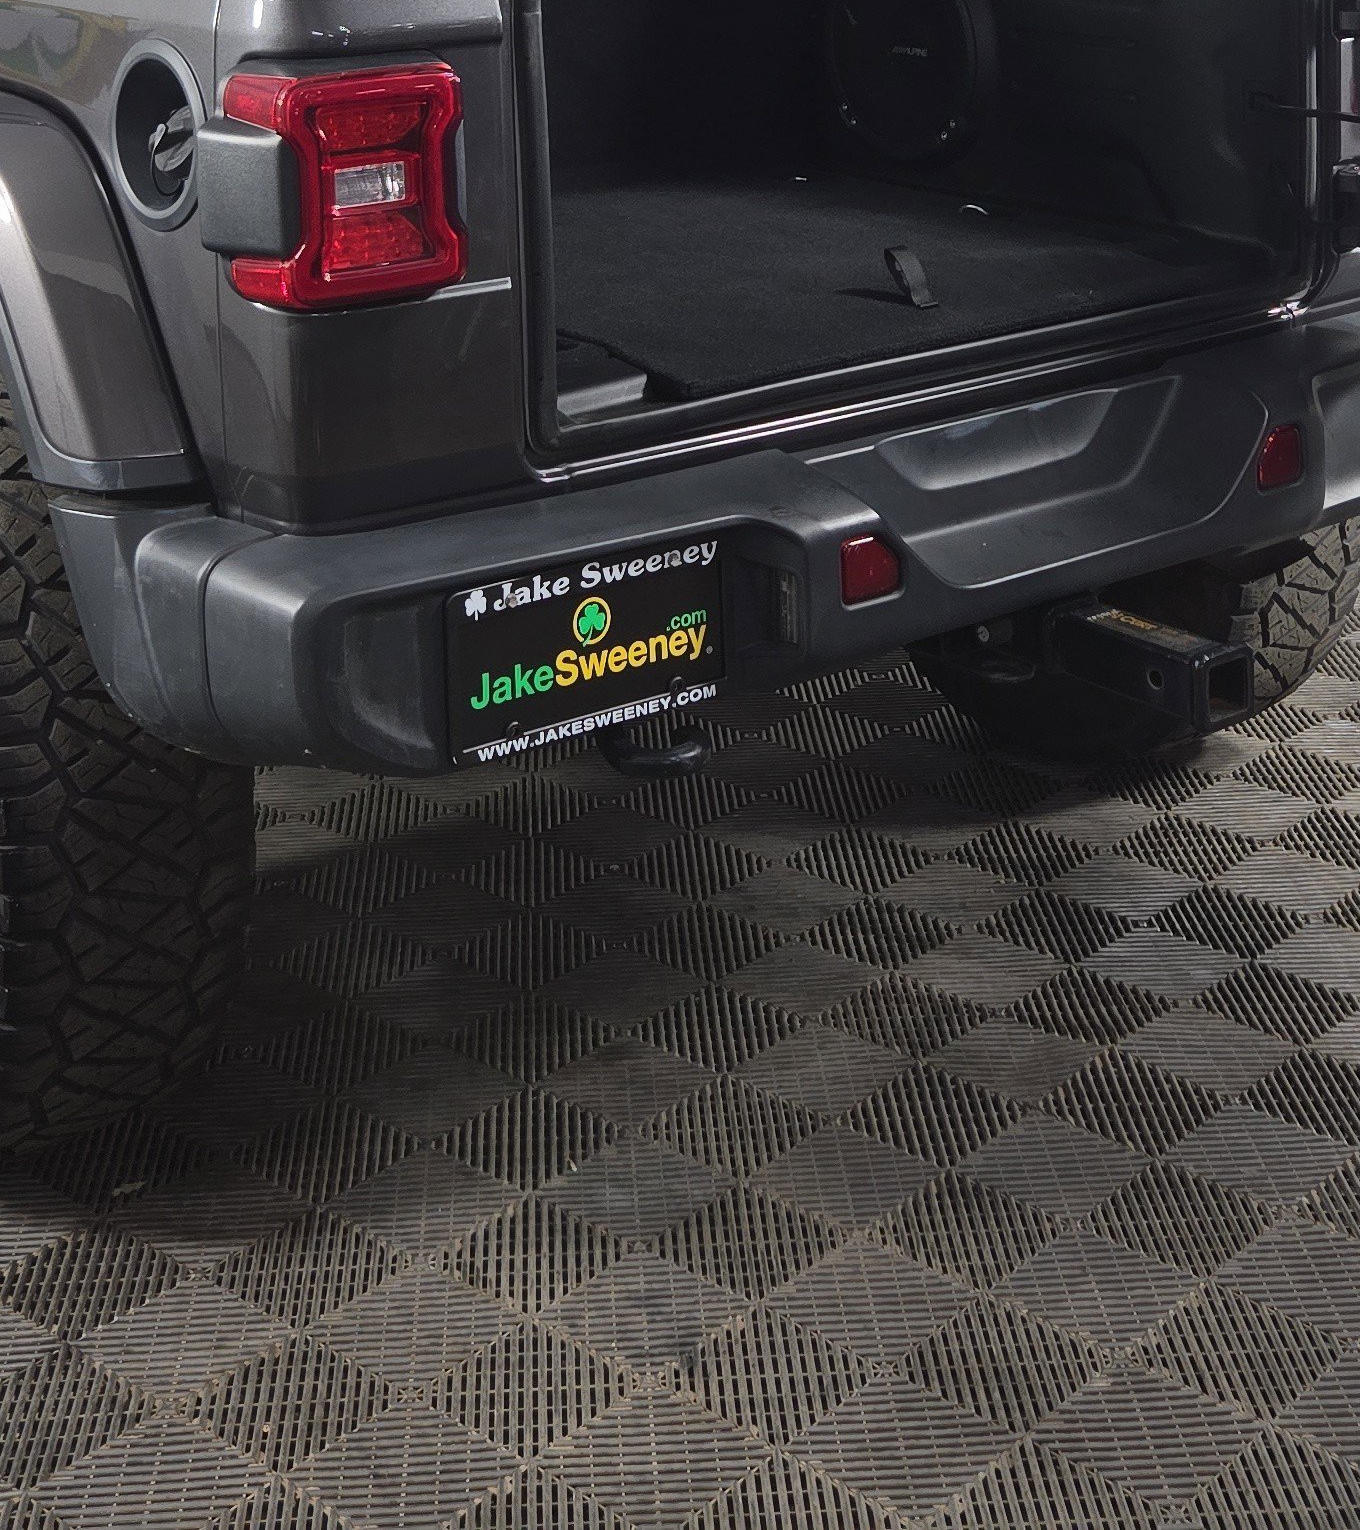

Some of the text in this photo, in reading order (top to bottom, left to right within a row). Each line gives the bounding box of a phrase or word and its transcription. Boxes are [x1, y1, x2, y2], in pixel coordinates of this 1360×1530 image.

[493, 540, 718, 609] Jake Sweeney
[478, 684, 717, 762] WWW.JAKESWEENEY.COM
